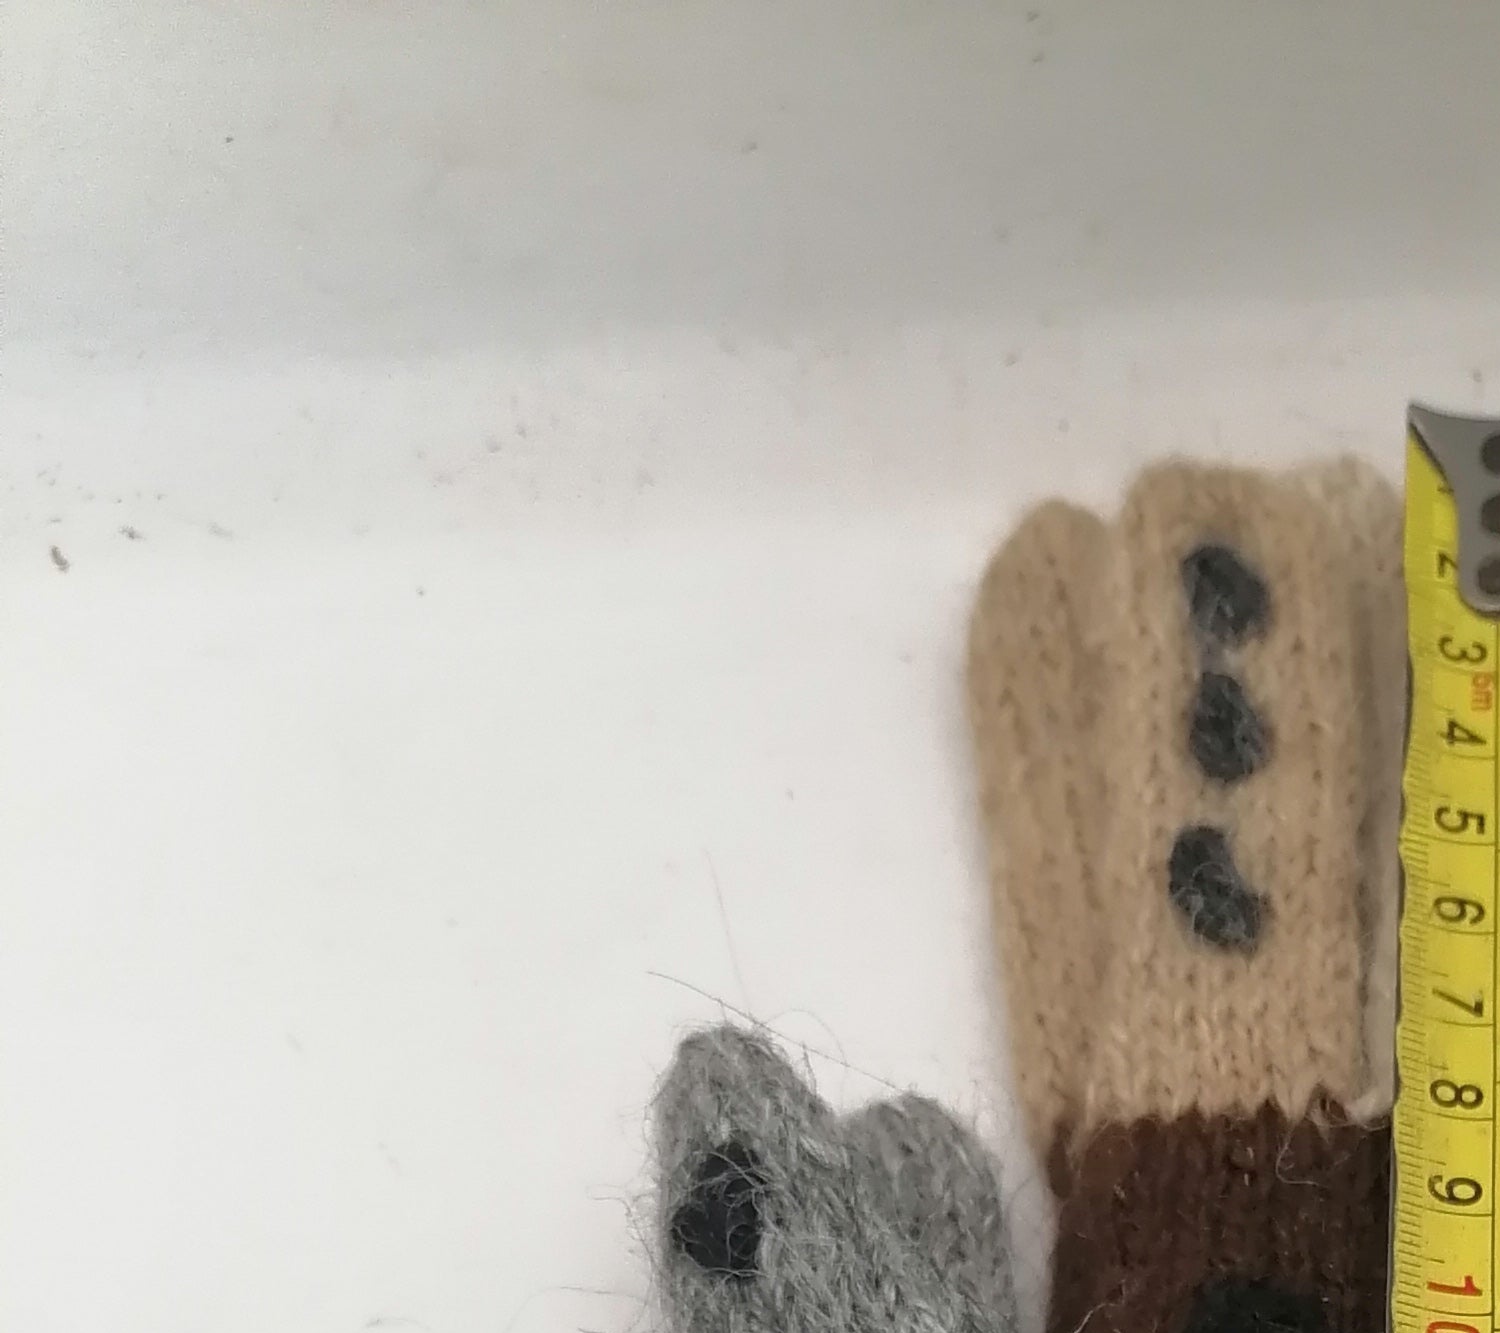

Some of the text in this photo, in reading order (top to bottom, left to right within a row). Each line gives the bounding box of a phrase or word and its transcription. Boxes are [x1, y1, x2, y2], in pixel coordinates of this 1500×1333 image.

[1438, 636, 1487, 665] 3
[1437, 717, 1487, 745] 4
[1435, 806, 1485, 836] 5
[1432, 896, 1485, 926] 6
[1432, 986, 1484, 1018] 7
[1430, 1079, 1484, 1110] 8
[1428, 1174, 1483, 1206] 9
